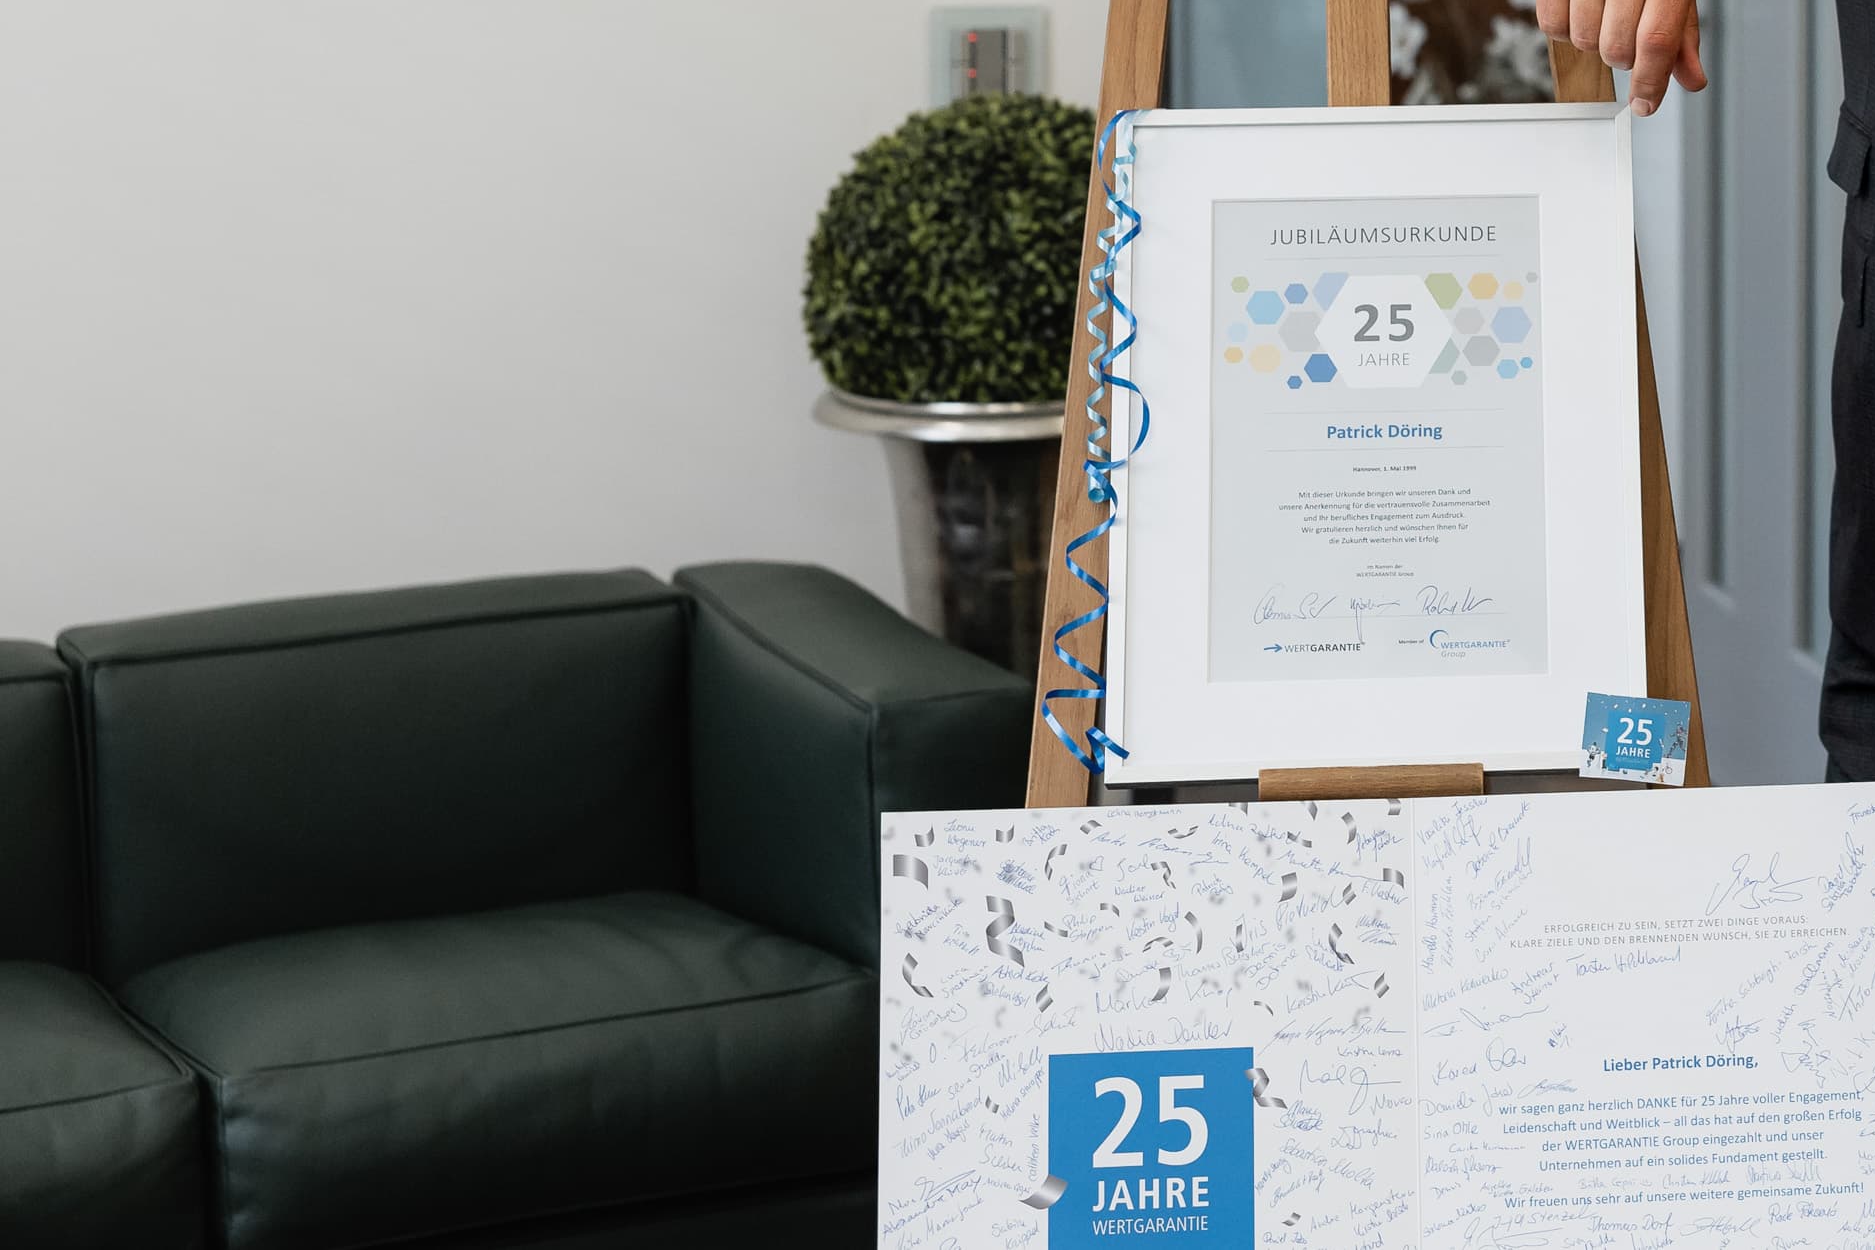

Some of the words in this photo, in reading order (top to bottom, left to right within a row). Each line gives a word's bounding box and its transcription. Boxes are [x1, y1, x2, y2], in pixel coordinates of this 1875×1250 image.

[1270, 225, 1497, 246] JUBILÄUMSURKUNDE
[1353, 304, 1415, 342] 25
[1357, 352, 1411, 367] JAHRE
[1326, 424, 1383, 439] Patrick
[1387, 423, 1443, 440] Döring
[1366, 490, 1394, 498] bringen
[1431, 500, 1490, 508] Zusammenarbeit
[1330, 513, 1369, 521] berufliches
[1370, 513, 1414, 521] Engagement
[1315, 526, 1354, 534] gratulieren
[1284, 643, 1361, 653] WERTGARANTIE
[1440, 640, 1506, 649] WERTGARANTIE
[1441, 650, 1466, 658] Group
[1616, 717, 1653, 746] 25
[1615, 746, 1651, 759] JAHRE
[1544, 923, 1615, 934] ERFOLGREICH
[1617, 922, 1632, 931] ZU
[1635, 921, 1661, 930] SEIN,
[1664, 919, 1694, 929] SETZT
[1697, 918, 1724, 928] ZWEI
[1727, 917, 1759, 927] DINGE
[1510, 938, 1543, 948] KLARE
[1546, 937, 1574, 947] ZIELE
[1577, 936, 1600, 946] UND
[1604, 935, 1625, 945] DEN
[1628, 933, 1699, 944] BRENNENDEN
[1702, 931, 1752, 941] WUNSCH,
[1754, 930, 1769, 939] SIE
[1773, 929, 1787, 939] ZU
[1602, 1056, 1649, 1072] Lieber
[1651, 1054, 1702, 1070] Patrick
[1705, 1053, 1759, 1070] Döring,
[1498, 1103, 1518, 1115] wir
[1520, 1103, 1555, 1117] sagen
[1557, 1102, 1585, 1116] ganz
[1587, 1097, 1634, 1111] herzlich
[1636, 1096, 1678, 1110] DANKE
[1680, 1093, 1698, 1108] für
[1700, 1094, 1716, 1107] 25
[1717, 1093, 1750, 1106] Jahre
[1751, 1091, 1786, 1105] voller
[1788, 1090, 1864, 1106] Engagement,
[1092, 1074, 1209, 1169] 25
[1502, 1119, 1577, 1134] Leidenschaft
[1579, 1118, 1603, 1131] und
[1604, 1115, 1661, 1130] Weitblick
[1673, 1114, 1688, 1127] all
[1689, 1113, 1713, 1127] das
[1713, 1113, 1733, 1126] hat
[1735, 1111, 1756, 1125] auf
[1757, 1111, 1781, 1124] den
[1782, 1109, 1825, 1125] großen
[1827, 1107, 1863, 1122] Erfolg
[1541, 1139, 1562, 1152] der
[1564, 1135, 1660, 1150] WERTGARANTIE
[1661, 1134, 1700, 1149] Group
[1702, 1131, 1763, 1147] eingezahlt
[1764, 1129, 1788, 1143] und
[1790, 1130, 1825, 1142] unser
[1538, 1157, 1622, 1172] Unternehmen
[1624, 1154, 1645, 1168] auf
[1647, 1154, 1665, 1166] ein
[1667, 1152, 1709, 1166] solides
[1711, 1150, 1780, 1163] Fundament
[1781, 1148, 1828, 1164] gestellt.
[1092, 1176, 1210, 1212] JAHRE
[1504, 1195, 1526, 1209] Wir
[1529, 1193, 1568, 1207] freuen
[1570, 1195, 1593, 1207] uns
[1594, 1192, 1622, 1207] sehr
[1623, 1190, 1645, 1205] auf
[1646, 1190, 1687, 1203] unsere
[1689, 1188, 1735, 1201] weitere
[1737, 1185, 1812, 1199] gemeinsame
[1814, 1181, 1864, 1194] Zukunft!
[1092, 1215, 1209, 1236] WERTGARANTIE
